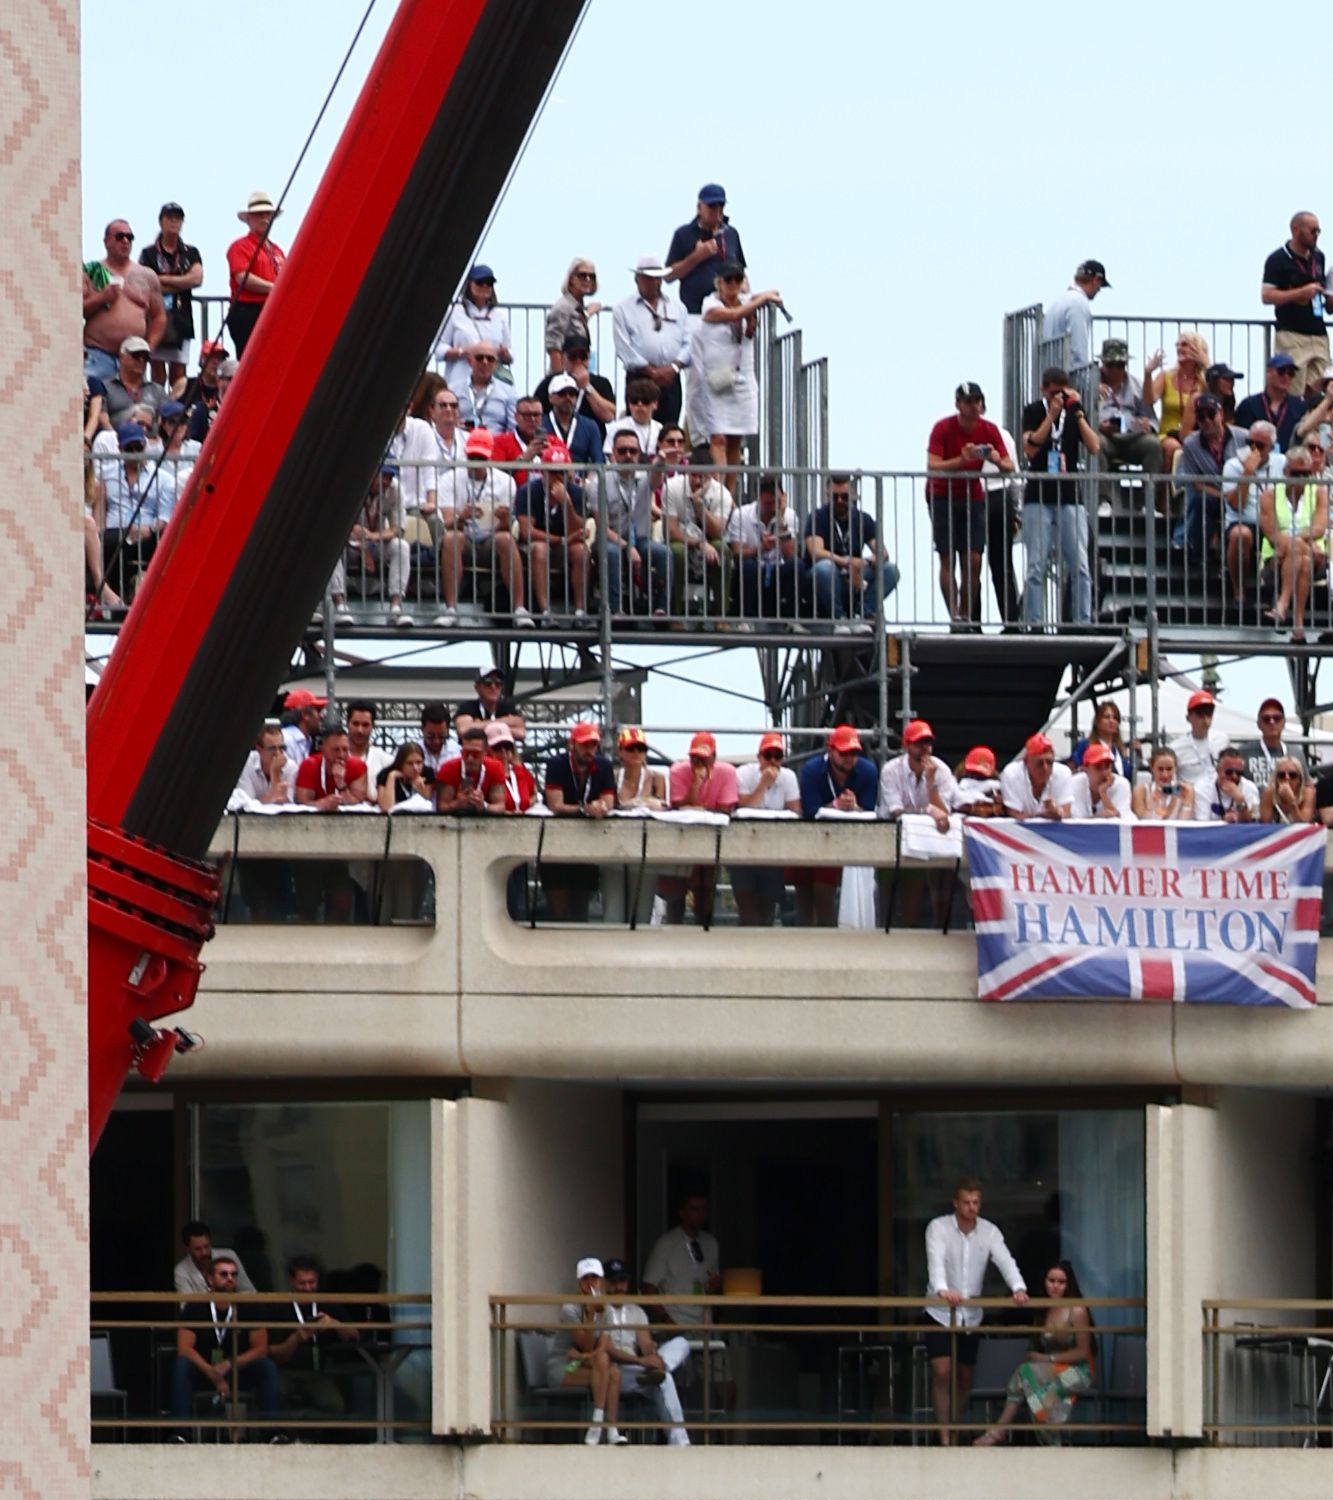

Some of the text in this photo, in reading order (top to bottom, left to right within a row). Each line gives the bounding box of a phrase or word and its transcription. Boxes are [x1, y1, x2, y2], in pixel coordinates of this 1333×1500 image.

[1010, 863, 1290, 900] HAMMER TIME
[1012, 902, 1290, 954] HAMILTON
